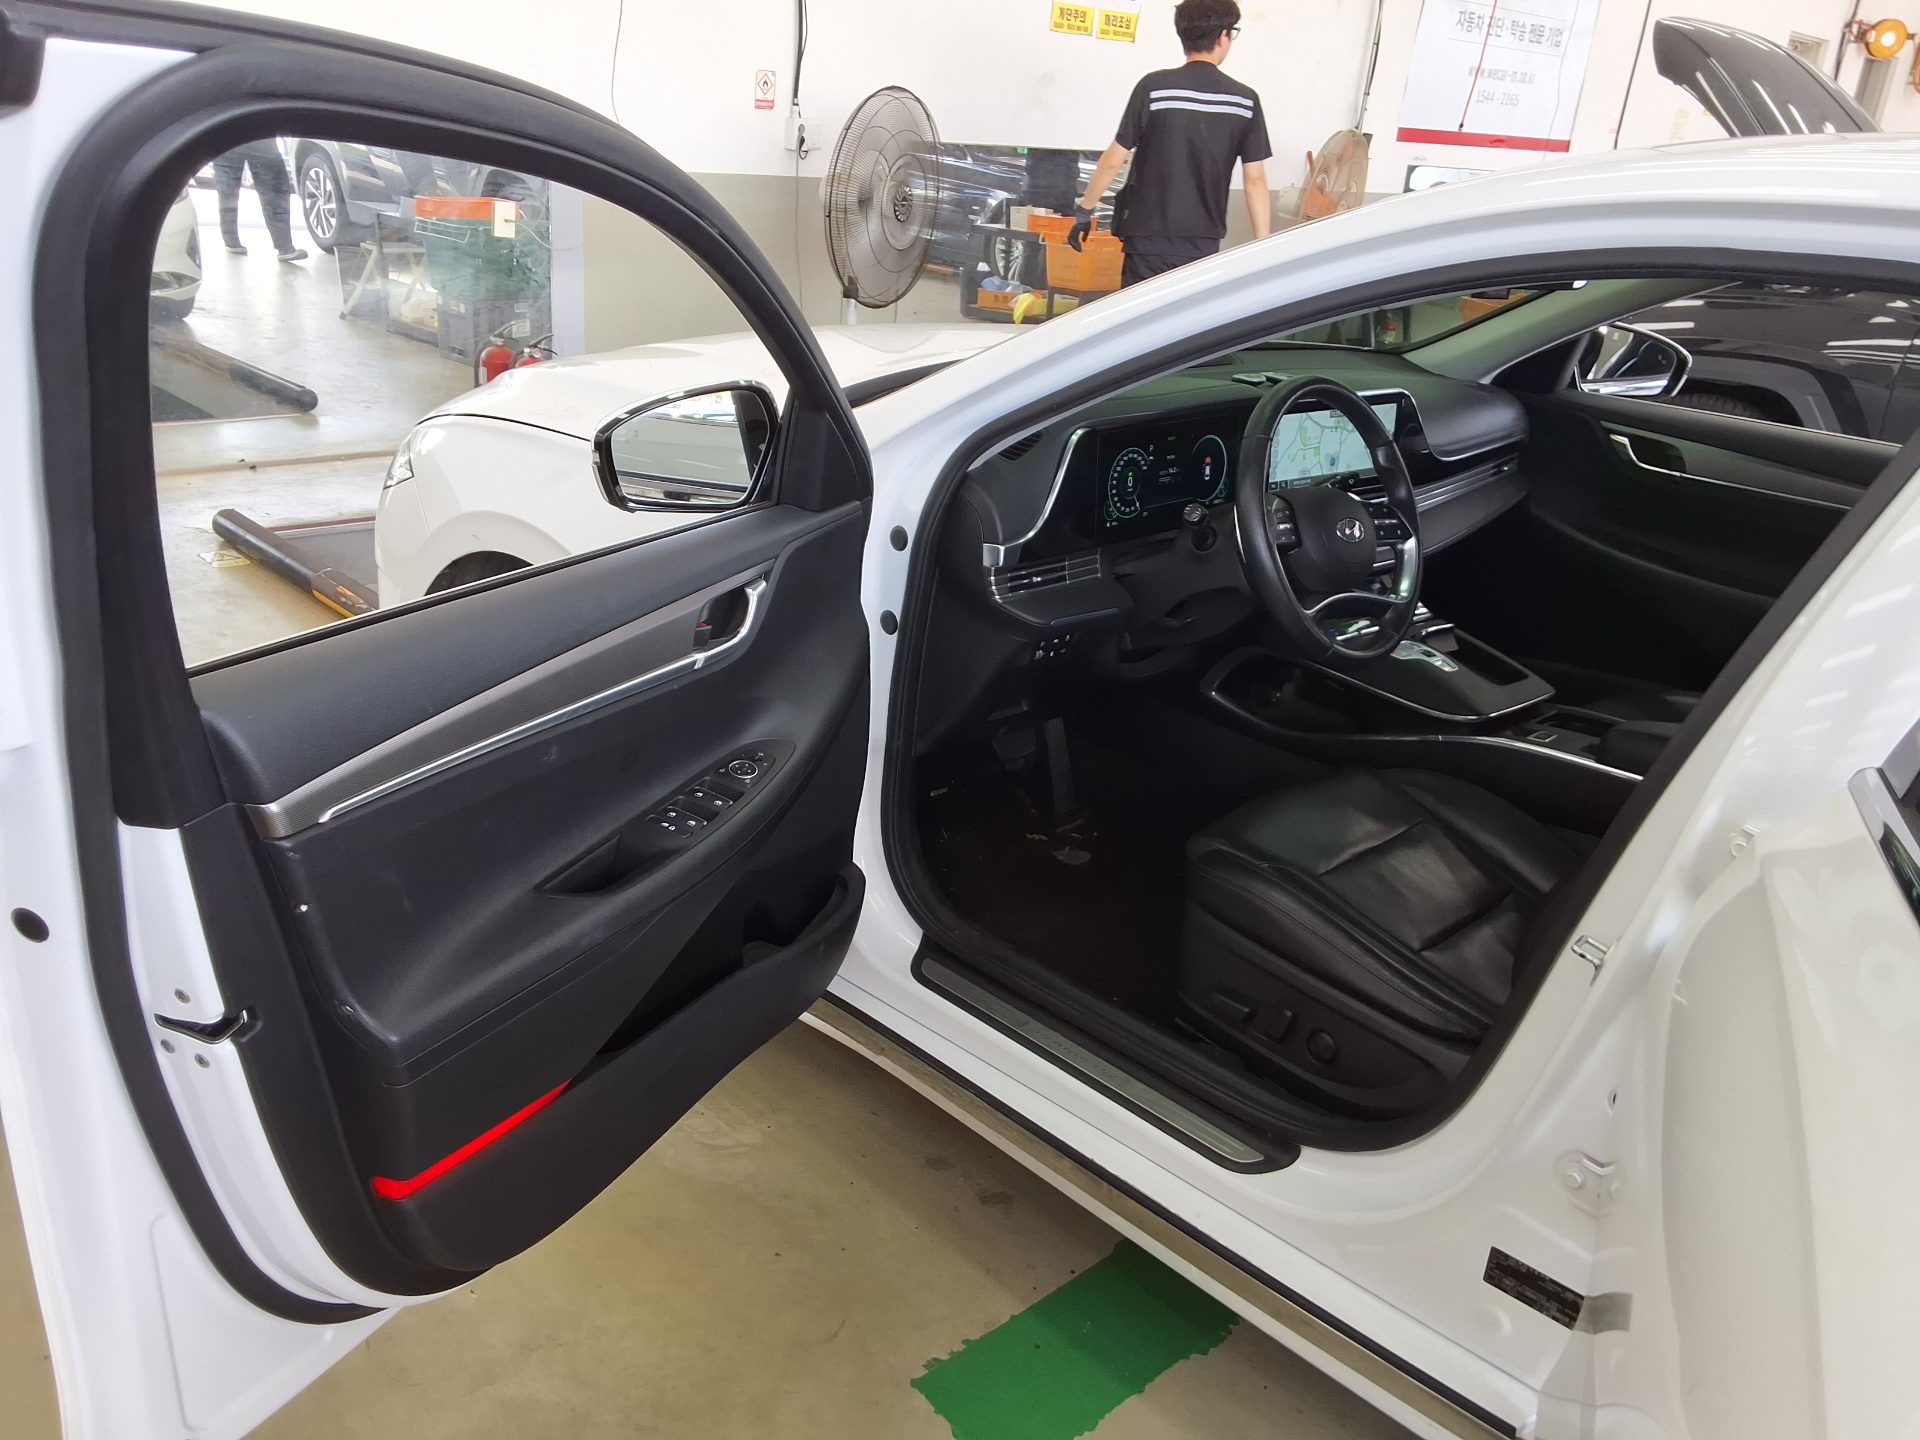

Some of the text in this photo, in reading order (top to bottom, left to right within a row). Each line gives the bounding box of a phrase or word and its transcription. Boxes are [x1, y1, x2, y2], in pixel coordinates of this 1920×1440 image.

[1456, 9, 1485, 35] 자동차
[1528, 22, 1546, 45] 전문
[1546, 26, 1564, 48] 기업
